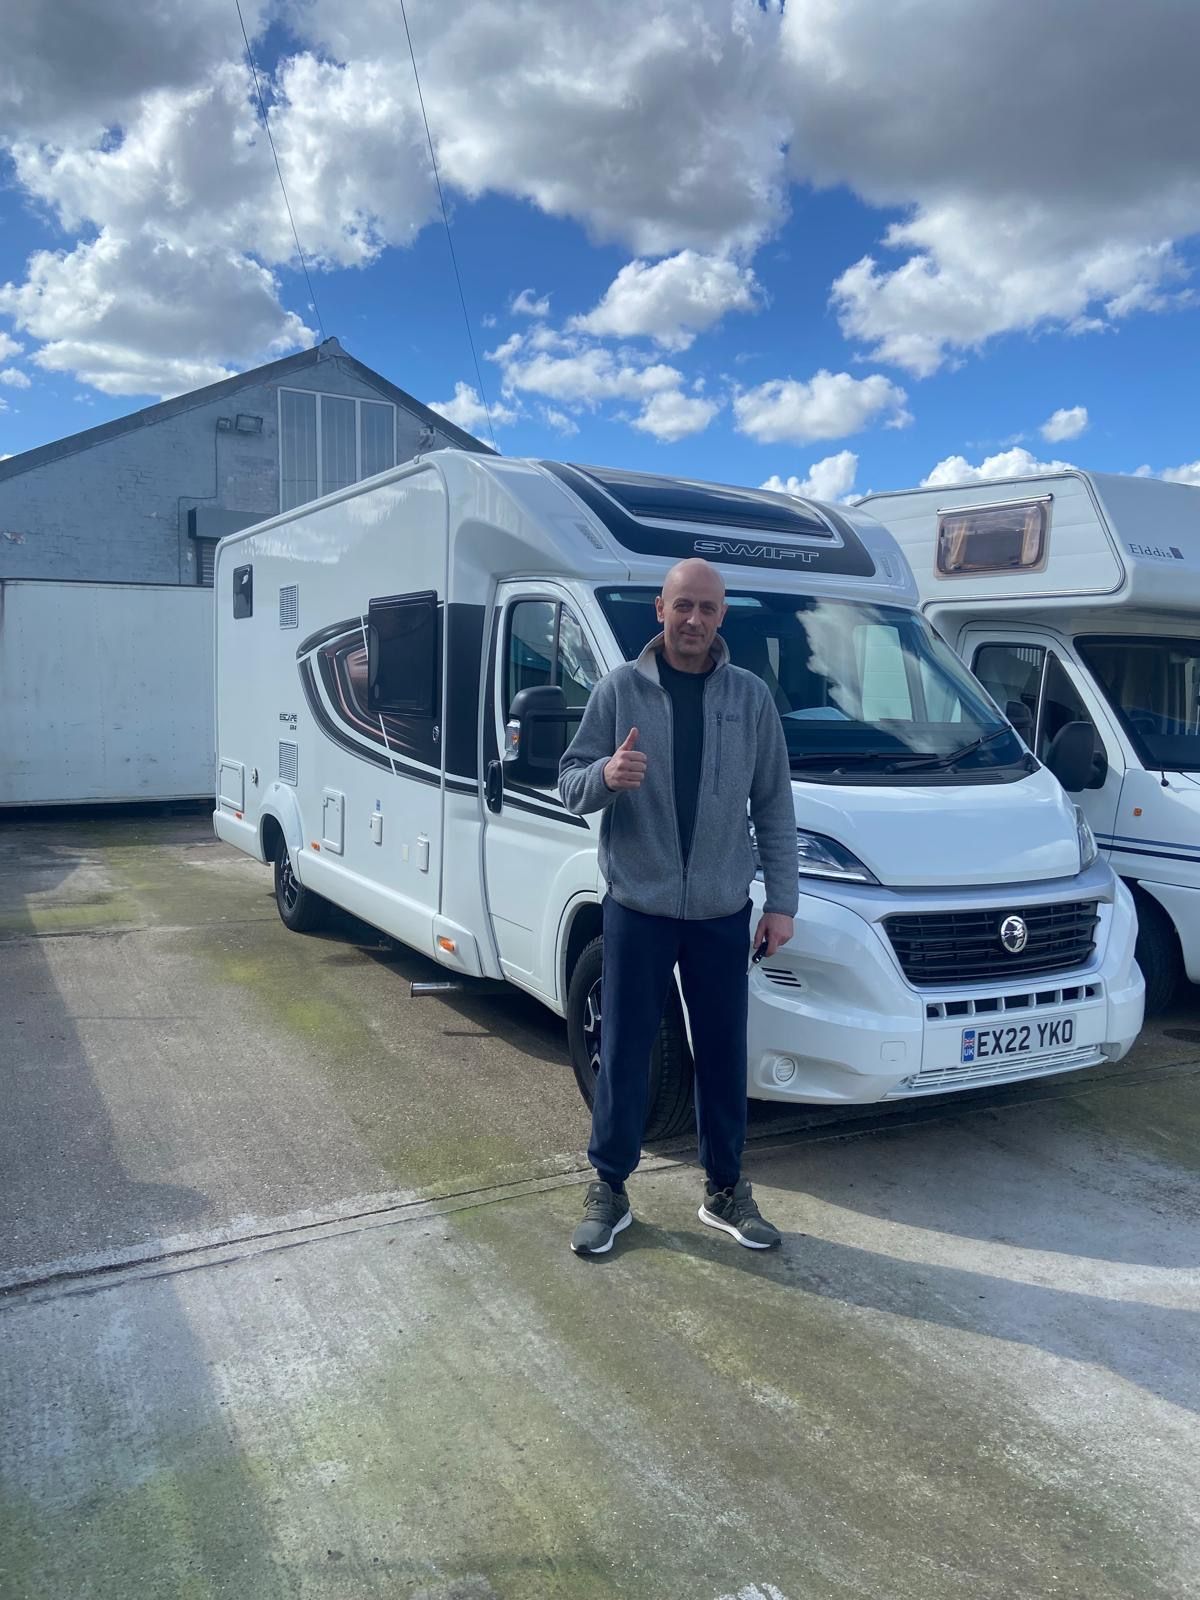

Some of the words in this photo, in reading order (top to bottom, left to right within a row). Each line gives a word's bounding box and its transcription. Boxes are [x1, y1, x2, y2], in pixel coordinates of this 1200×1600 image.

[694, 540, 819, 563] SWIFT
[1128, 543, 1172, 558] Elddis
[977, 1026, 1031, 1057] EX22
[1037, 1019, 1073, 1047] YKO
[964, 1048, 974, 1056] UK
